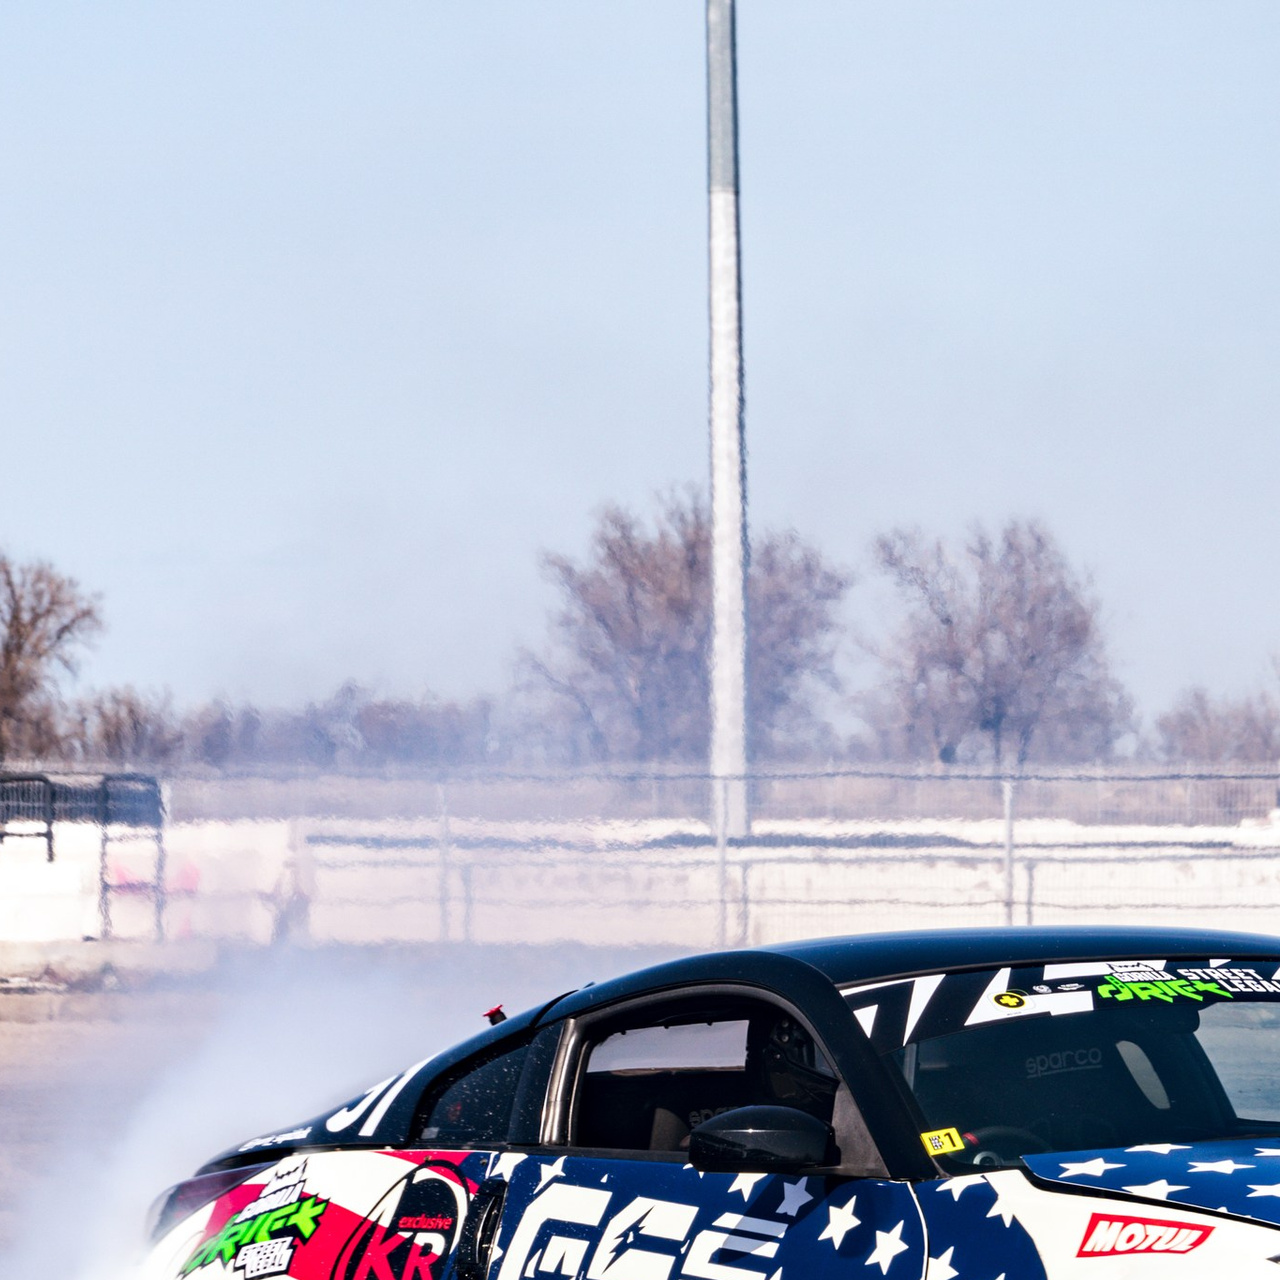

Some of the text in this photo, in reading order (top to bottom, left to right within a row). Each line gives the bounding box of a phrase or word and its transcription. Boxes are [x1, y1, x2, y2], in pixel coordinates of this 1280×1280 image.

[1112, 971, 1177, 982] GORILLA
[1177, 968, 1263, 980] STREET
[1098, 976, 1234, 1003] DRIFT
[1025, 1047, 1102, 1077] sparco
[398, 1213, 453, 1230] exclusive
[1082, 1220, 1204, 1252] MOTUL
